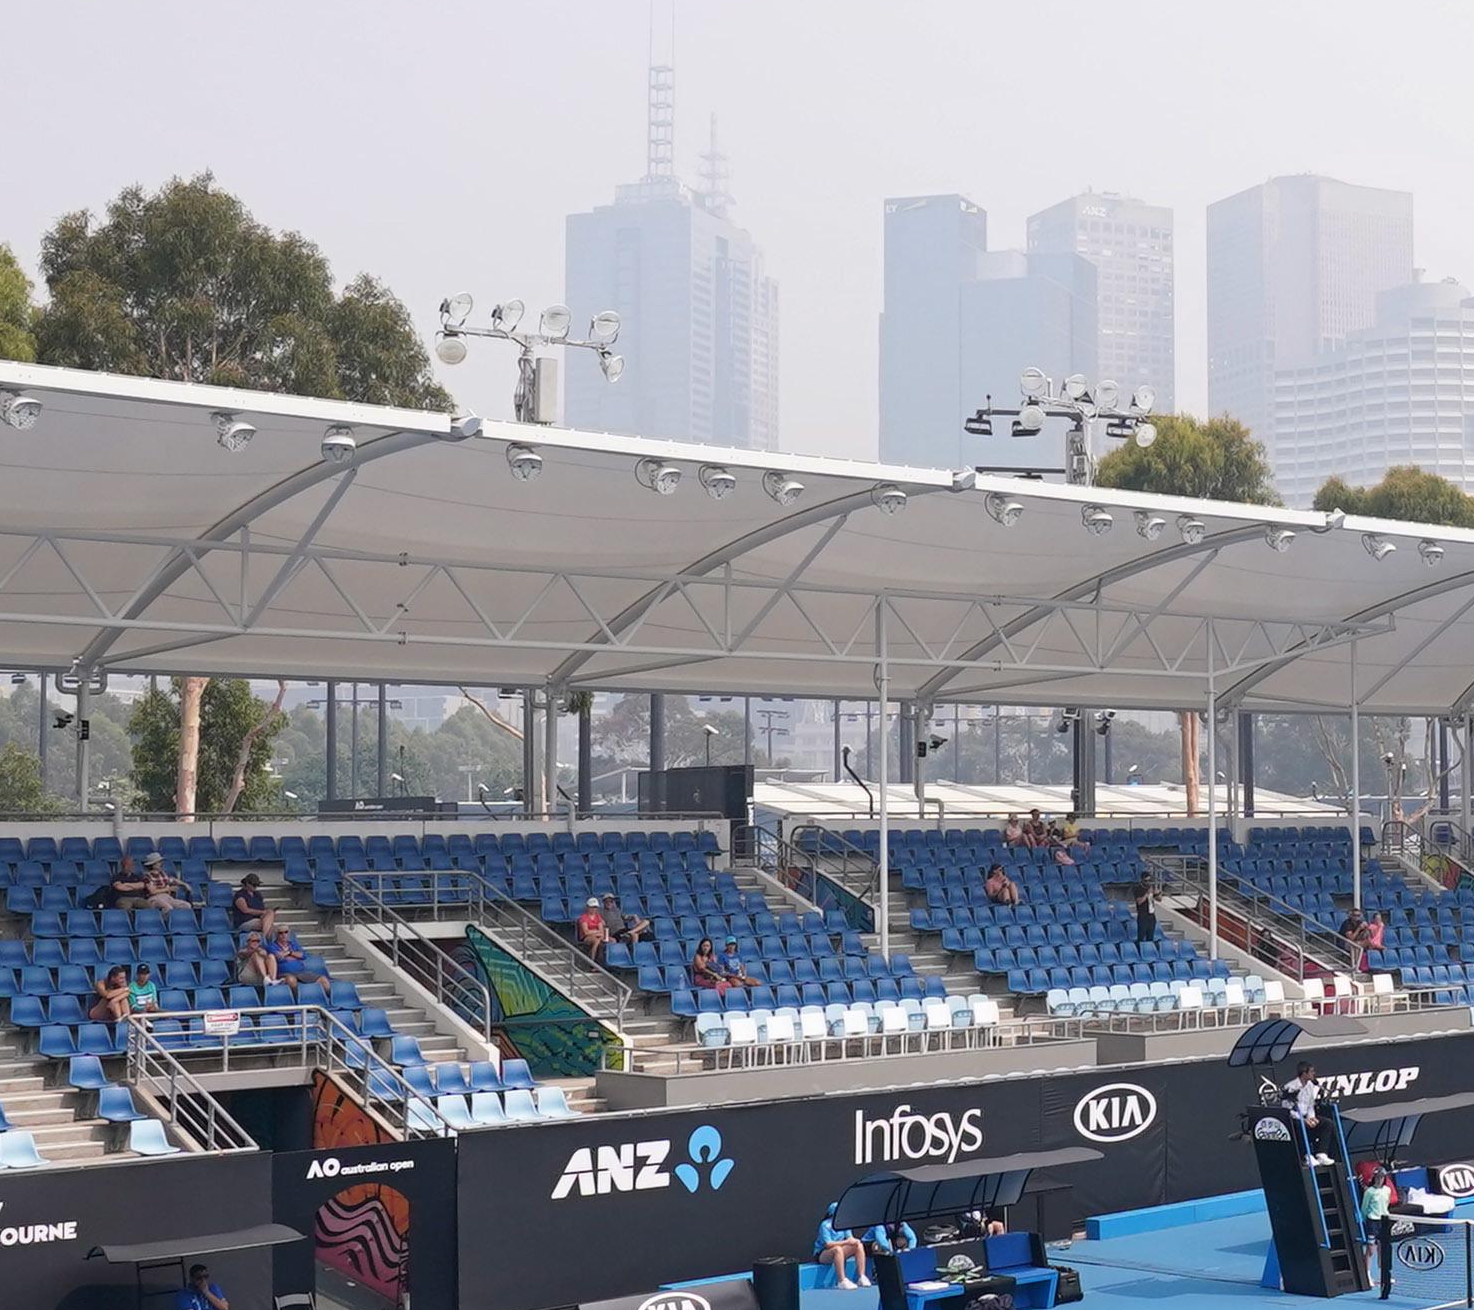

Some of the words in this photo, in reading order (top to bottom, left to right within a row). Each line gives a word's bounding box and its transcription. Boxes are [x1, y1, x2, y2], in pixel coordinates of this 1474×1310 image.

[1316, 1066, 1420, 1099] UNLOP
[1088, 1095, 1144, 1132] KIA
[855, 1104, 983, 1165] Infosys
[306, 1158, 340, 1179] AO
[341, 1162, 388, 1175] australian
[389, 1160, 414, 1172] open
[551, 1139, 671, 1199] ANZ
